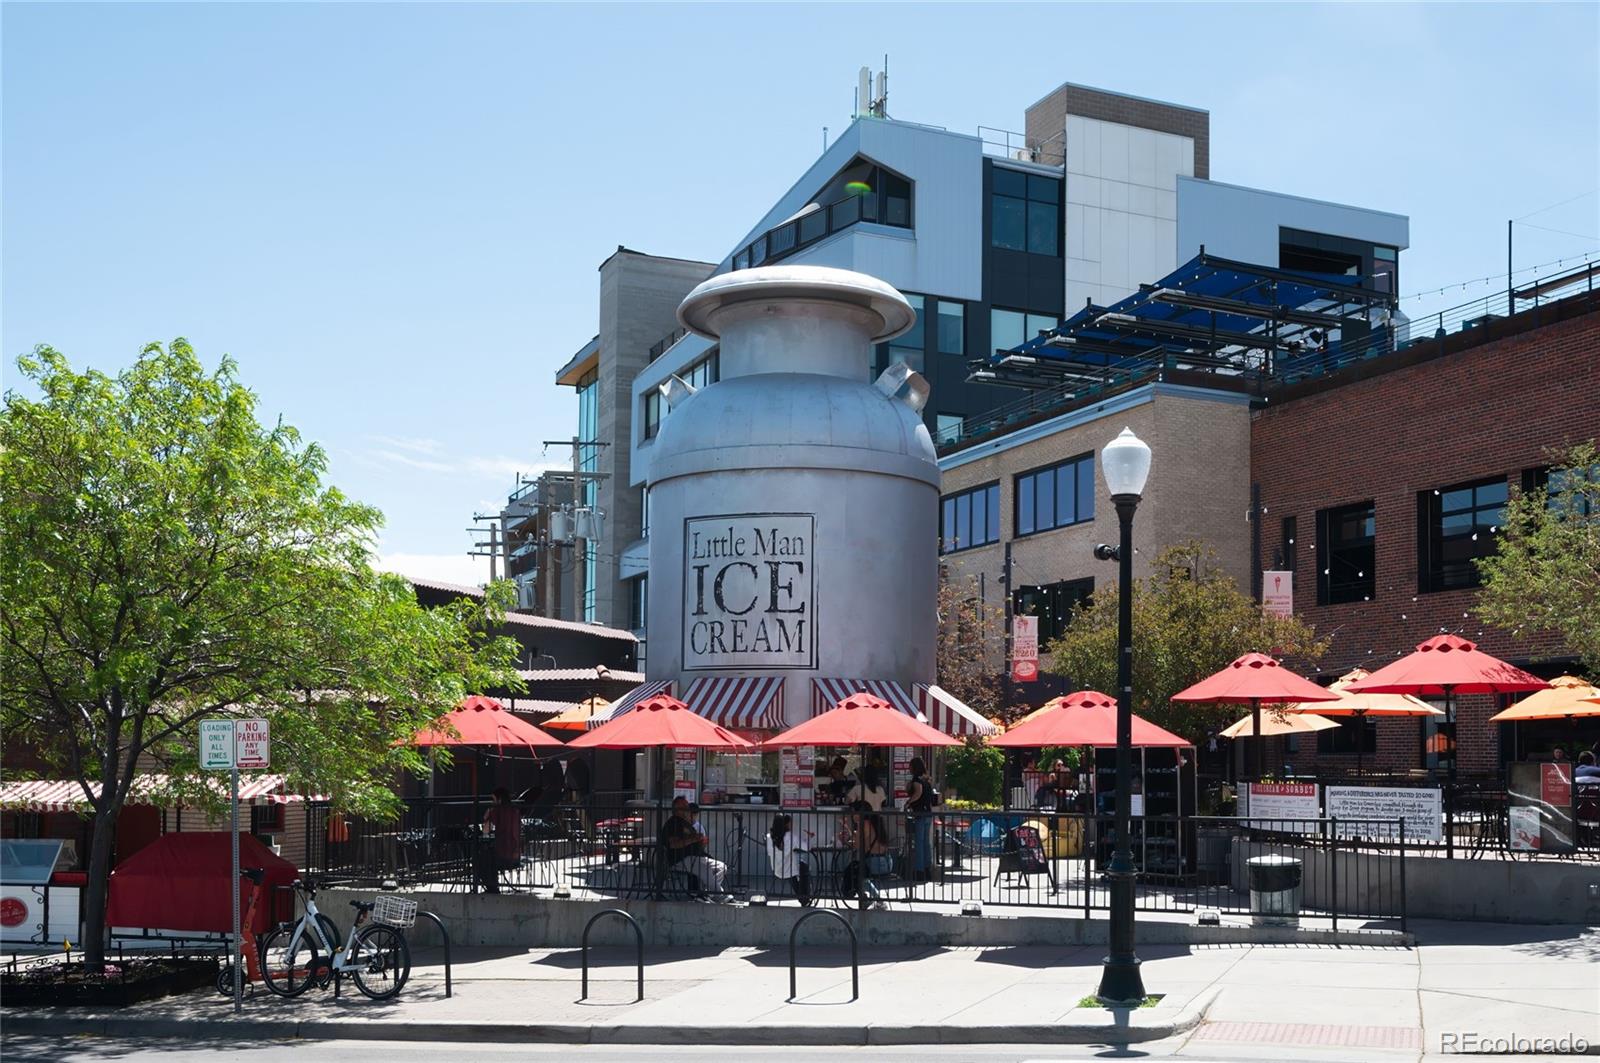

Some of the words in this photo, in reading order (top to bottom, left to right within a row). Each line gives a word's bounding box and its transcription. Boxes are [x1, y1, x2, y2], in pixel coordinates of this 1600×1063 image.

[692, 526, 746, 560] Little
[752, 527, 805, 557] Man
[691, 560, 806, 616] ICE
[691, 618, 806, 655] CREAM
[203, 724, 232, 732] LOADING
[245, 722, 259, 732] NO
[237, 732, 267, 742] PARKING
[1285, 784, 1314, 794] SORBET
